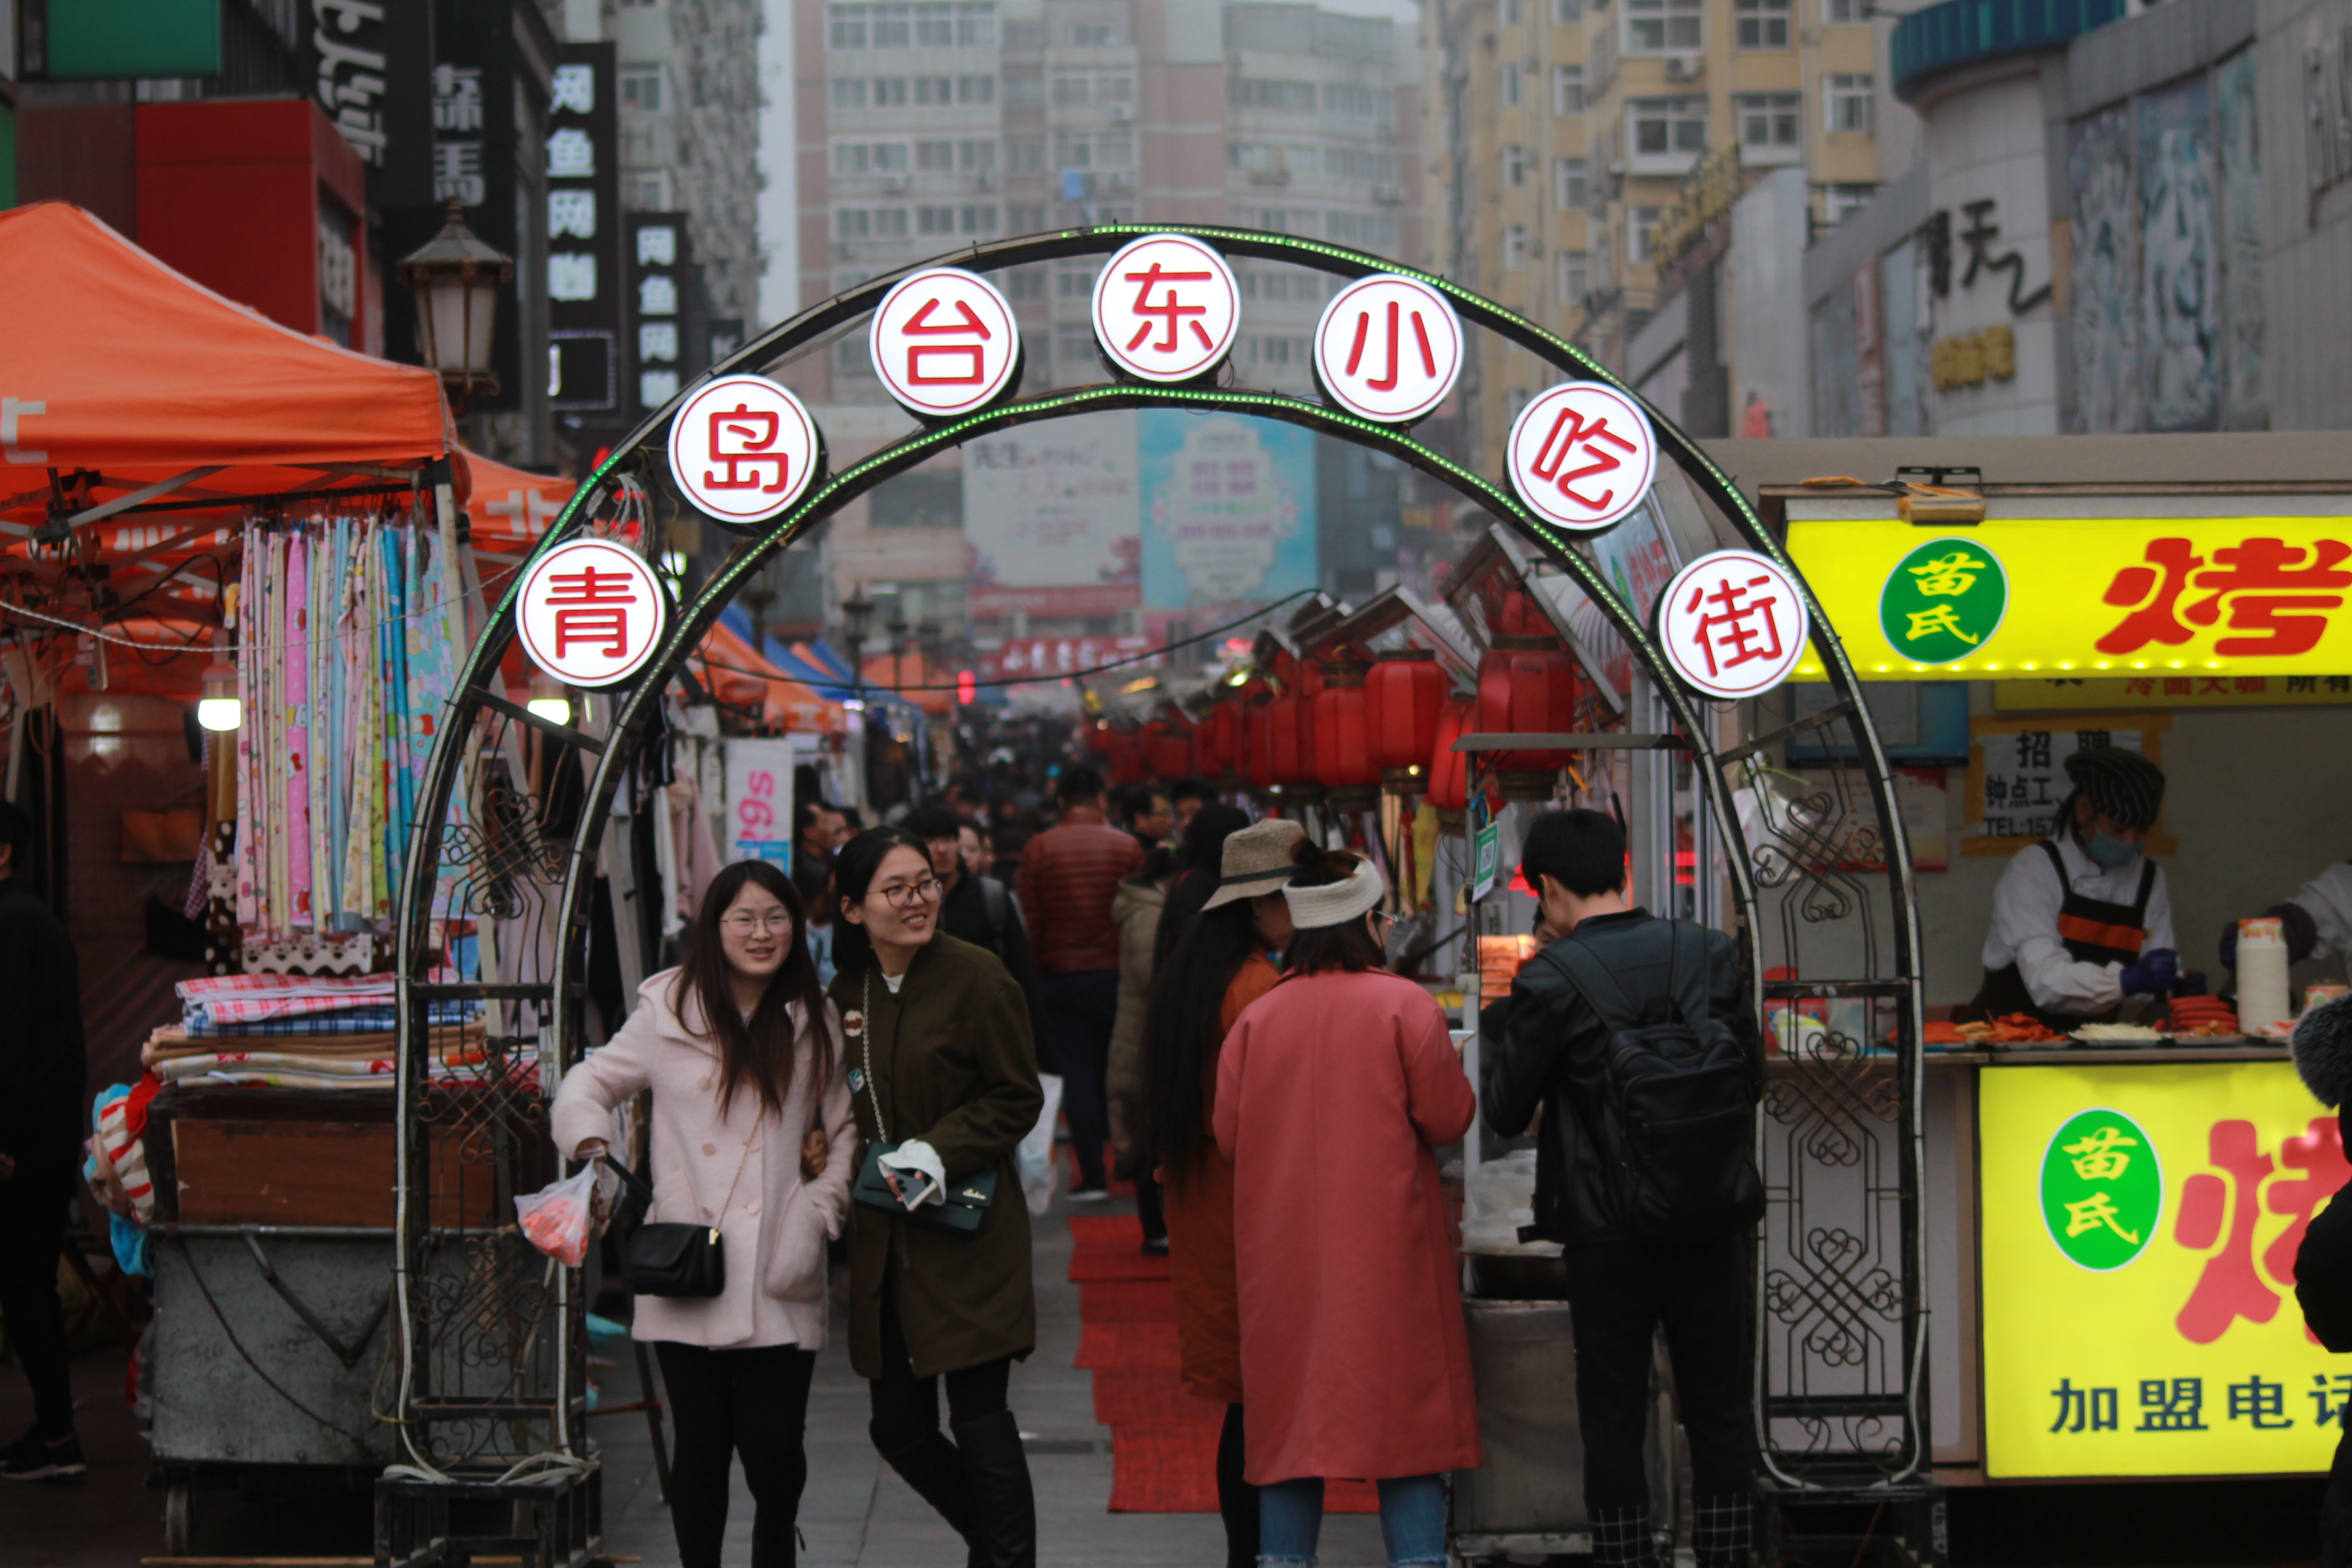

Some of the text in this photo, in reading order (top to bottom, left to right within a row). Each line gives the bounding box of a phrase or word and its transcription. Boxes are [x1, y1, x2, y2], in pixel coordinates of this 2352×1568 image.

[546, 263, 1782, 676] 青岛台东小吃街
[1906, 552, 1985, 645] 苗氏
[2095, 538, 2352, 656] 烤
[2062, 1126, 2140, 1245] 苗氏
